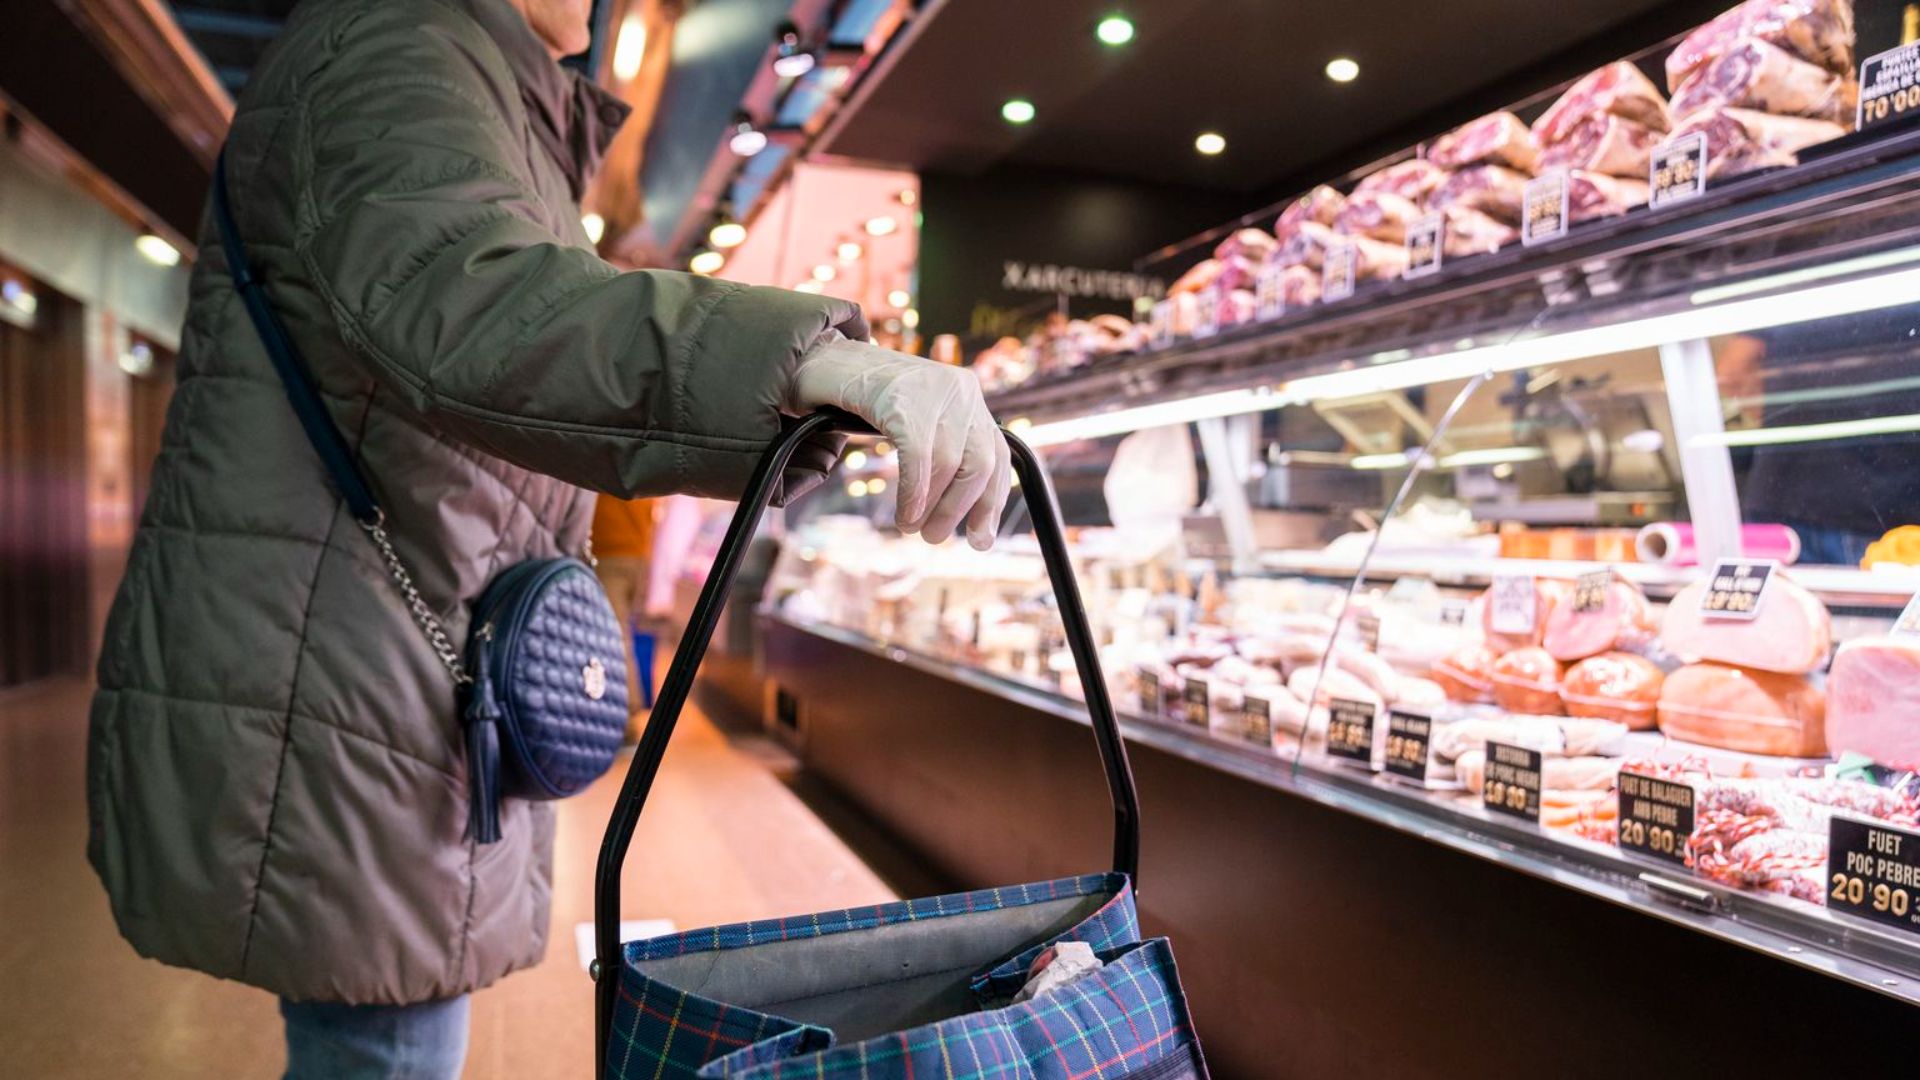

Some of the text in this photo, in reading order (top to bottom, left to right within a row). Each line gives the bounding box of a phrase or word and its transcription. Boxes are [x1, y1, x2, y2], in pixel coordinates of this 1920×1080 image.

[1619, 774, 1692, 809] FUET DE BALAGUER
[1621, 818, 1674, 855] 20'90
[1868, 829, 1902, 856] FUET
[1847, 850, 1920, 889] POC PEBRE
[1830, 872, 1909, 917] 20'90
